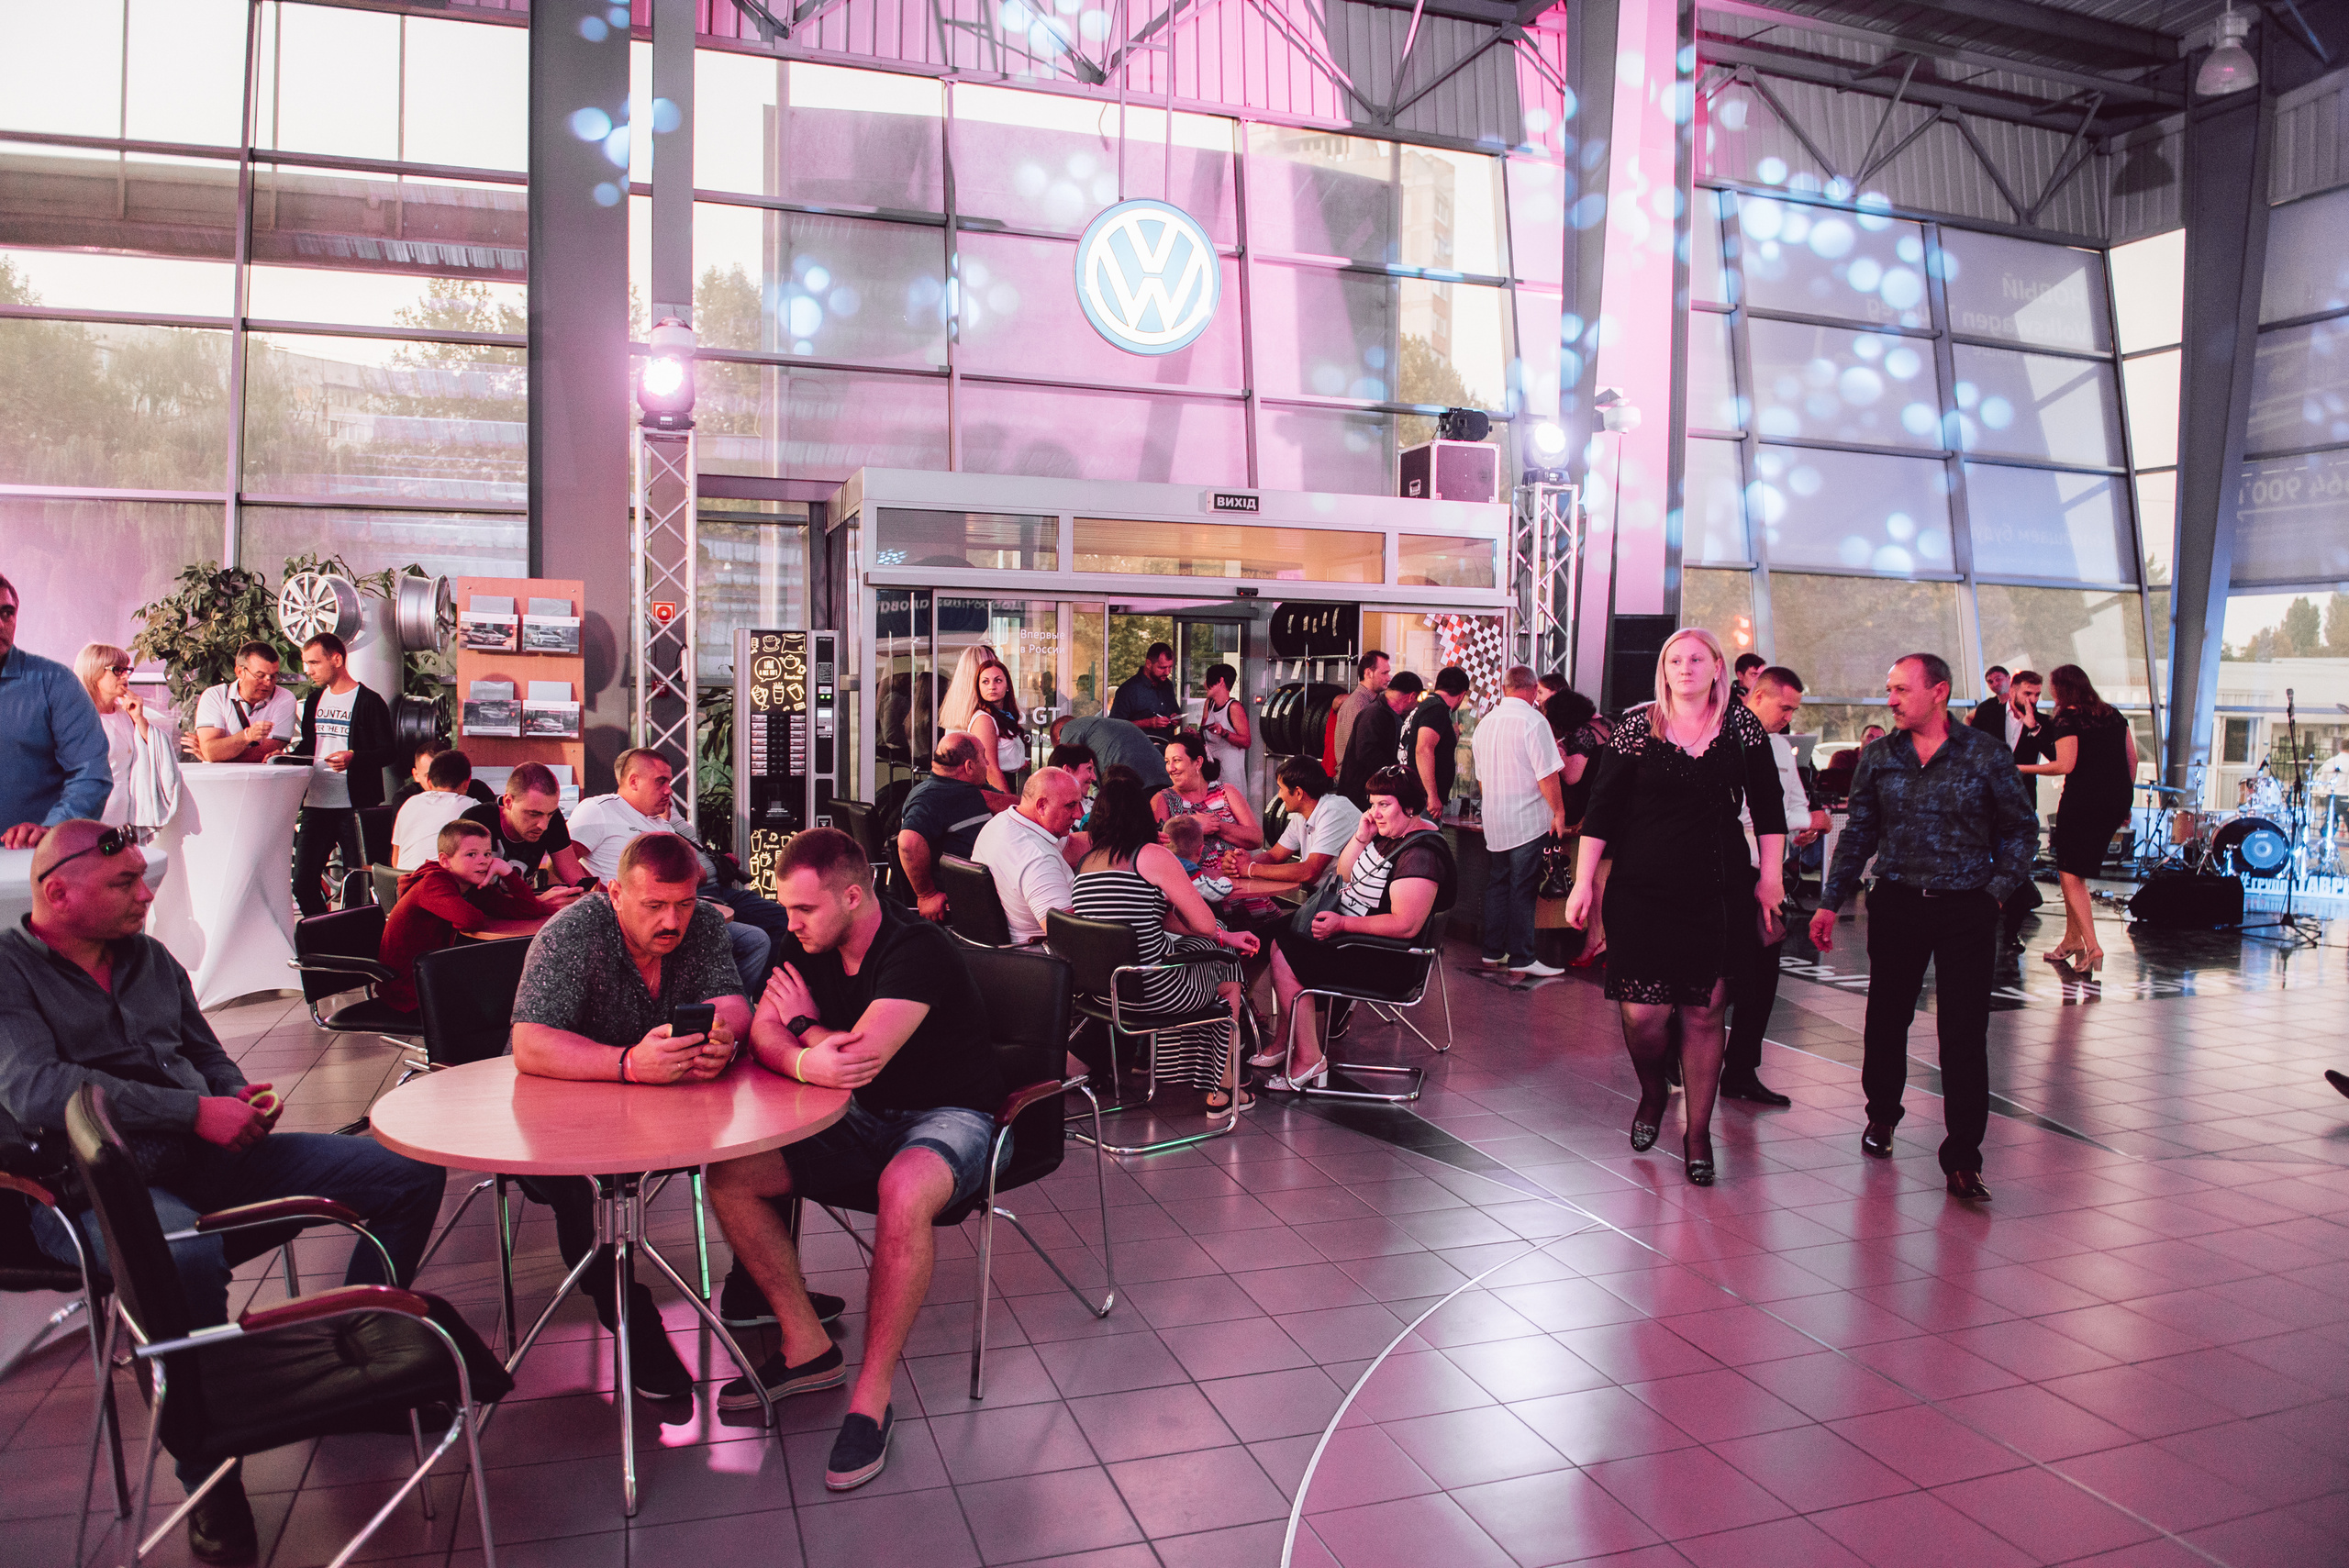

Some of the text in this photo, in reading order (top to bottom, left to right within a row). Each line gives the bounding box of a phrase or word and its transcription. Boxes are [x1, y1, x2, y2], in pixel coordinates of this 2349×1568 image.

[1217, 496, 1257, 510] ВИХІД
[1020, 629, 1064, 641] Впервые
[1029, 644, 1064, 654] России
[317, 708, 352, 720] OUNTAI
[1032, 706, 1061, 725] GT
